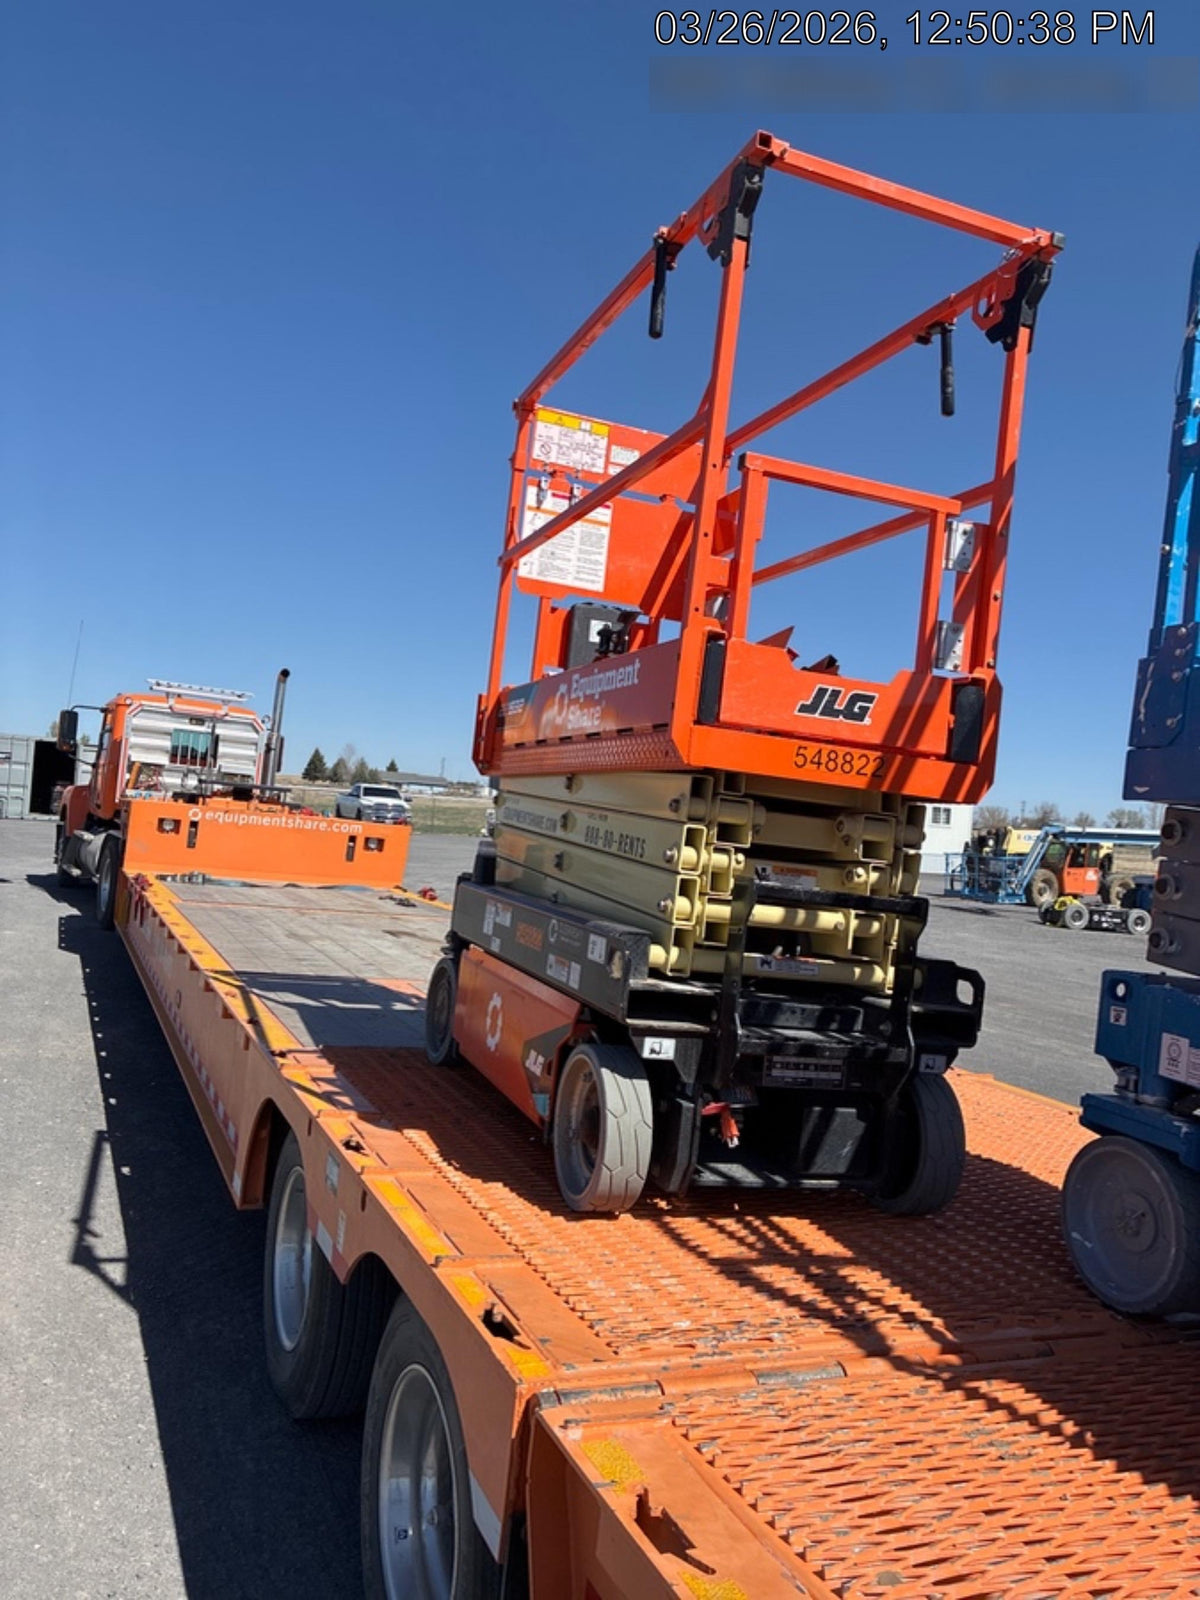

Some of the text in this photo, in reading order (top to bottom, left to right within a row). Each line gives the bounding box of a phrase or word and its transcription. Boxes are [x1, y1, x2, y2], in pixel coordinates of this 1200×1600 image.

[570, 658, 641, 702] Equipment
[567, 703, 602, 729] Share
[795, 685, 878, 724] JLG
[794, 745, 885, 778] 548822
[205, 811, 363, 834] equipmentshare.com
